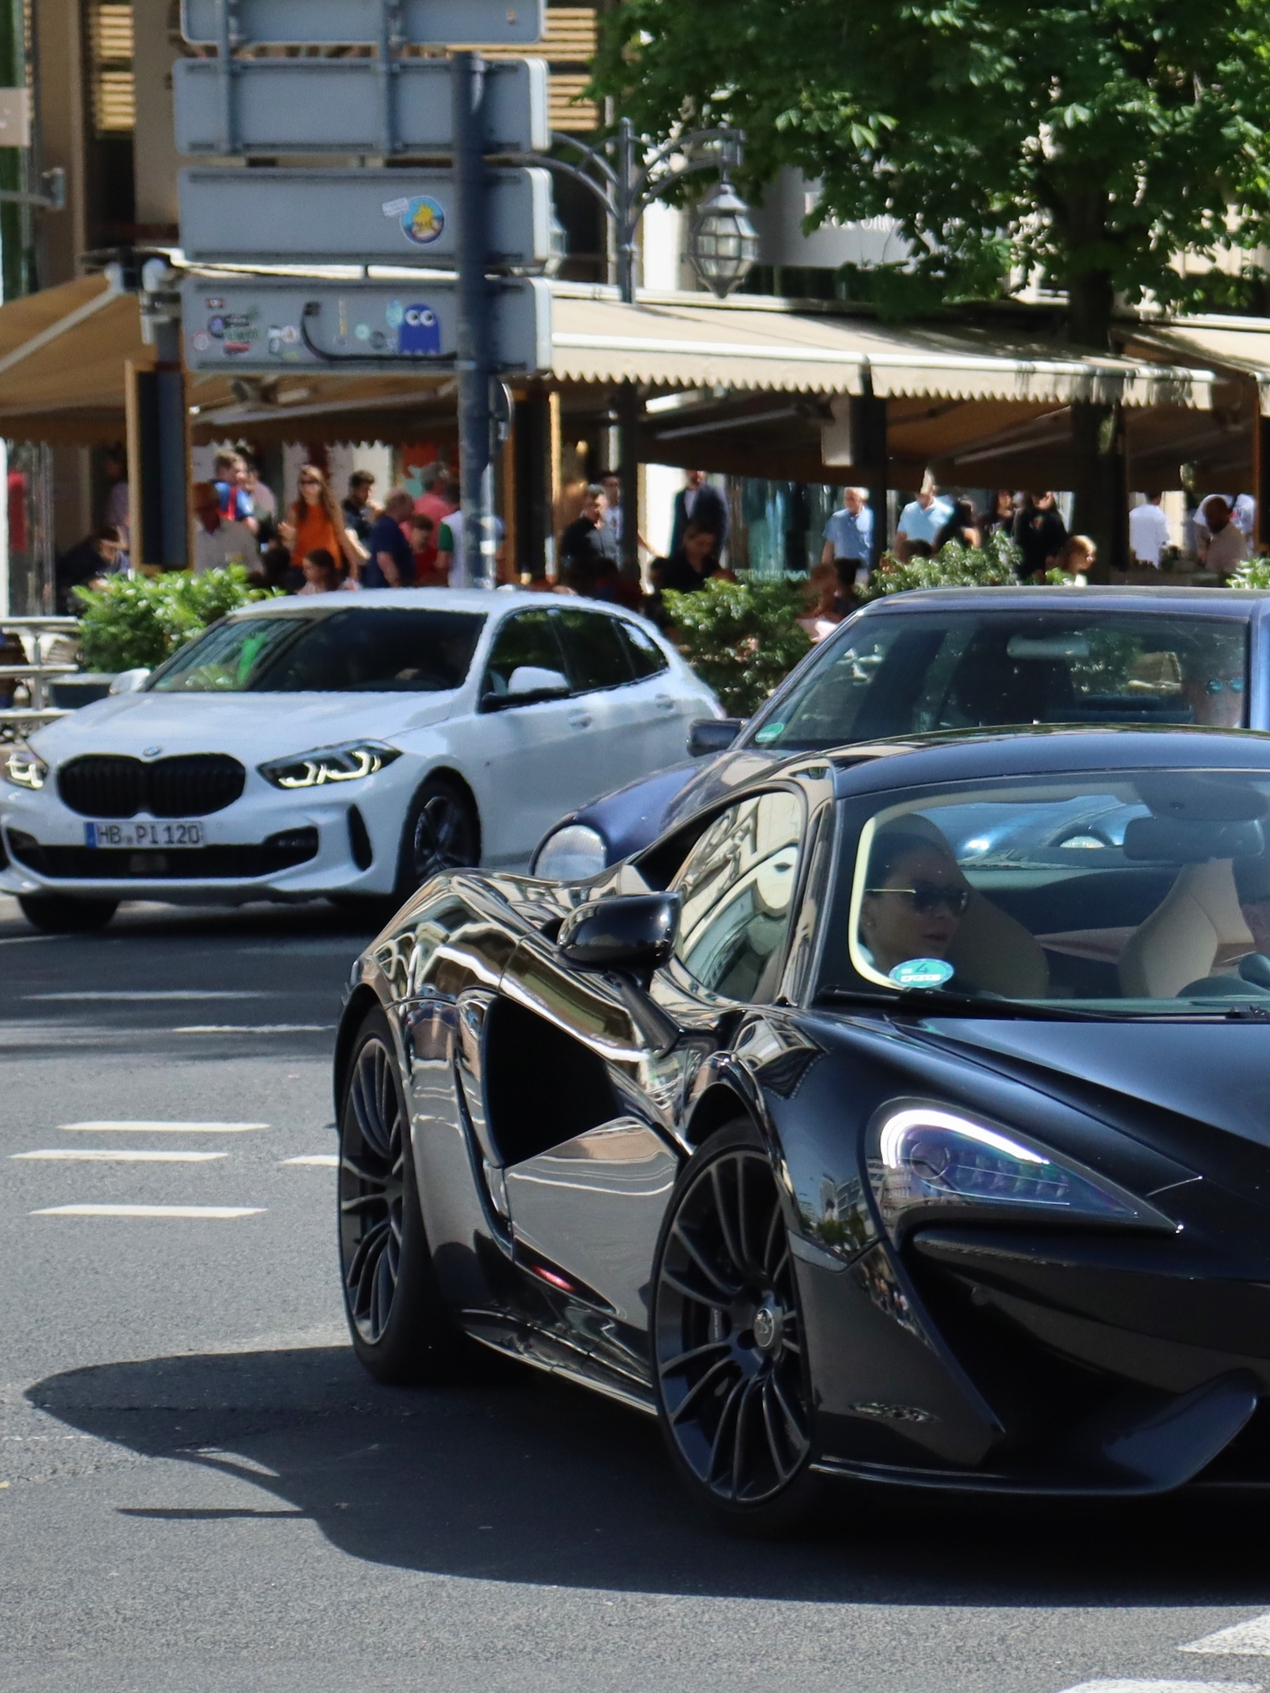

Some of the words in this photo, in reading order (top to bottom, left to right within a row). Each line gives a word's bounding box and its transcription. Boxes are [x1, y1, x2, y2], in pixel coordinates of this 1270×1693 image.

[97, 825, 122, 844] HB
[135, 825, 159, 844] PI
[163, 825, 201, 844] 120
